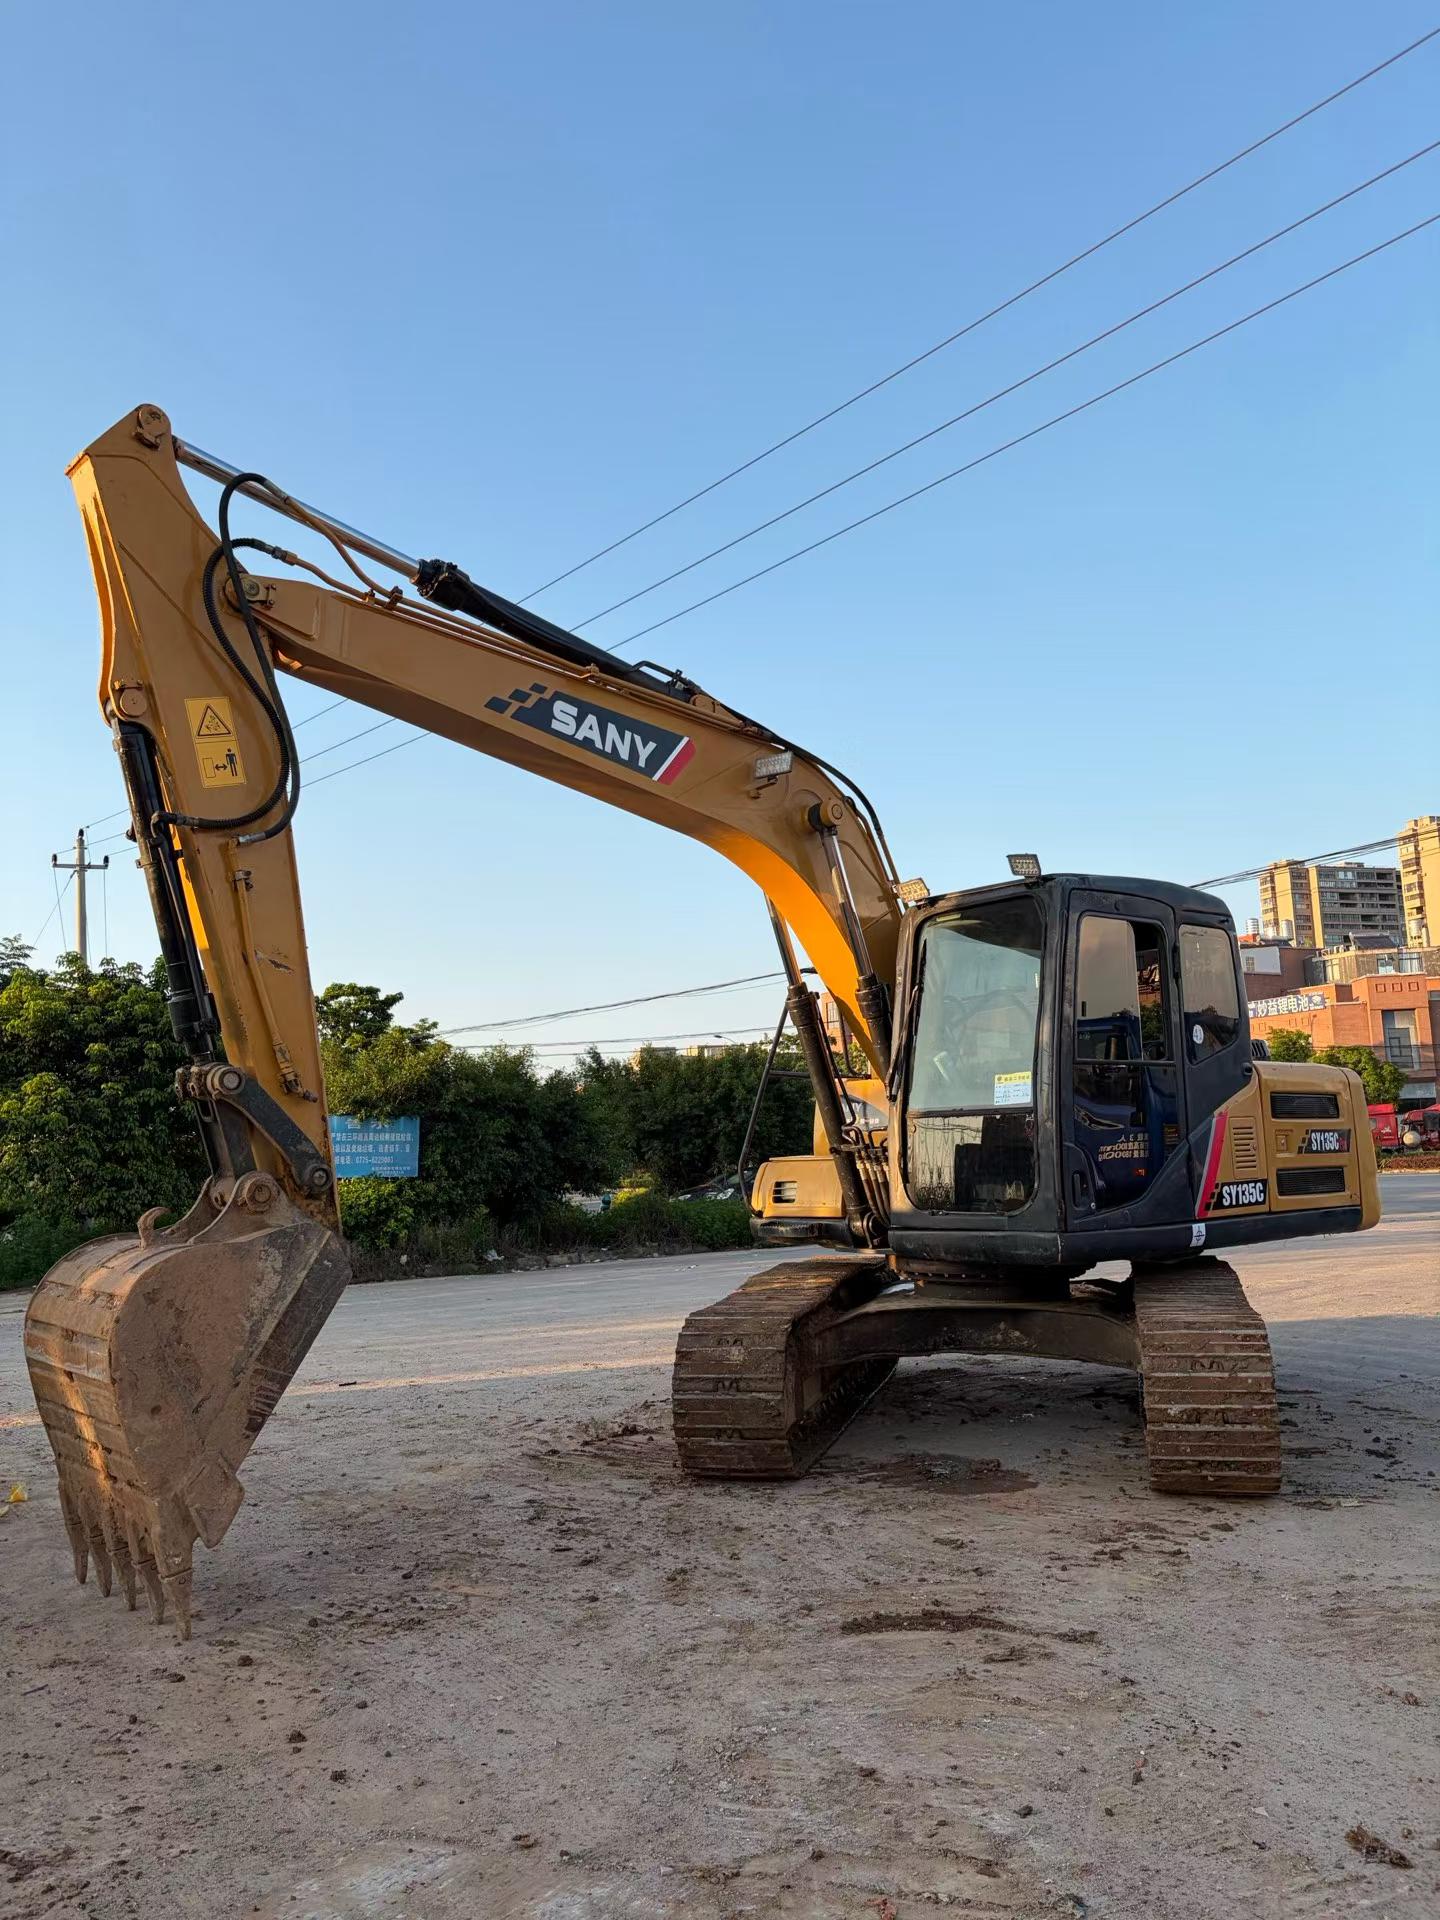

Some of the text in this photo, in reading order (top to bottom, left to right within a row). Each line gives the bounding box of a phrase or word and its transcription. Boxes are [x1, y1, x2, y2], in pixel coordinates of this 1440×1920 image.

[551, 700, 657, 768] SANY
[1311, 1131, 1340, 1151] SY135C
[1222, 1182, 1264, 1206] SY135C
